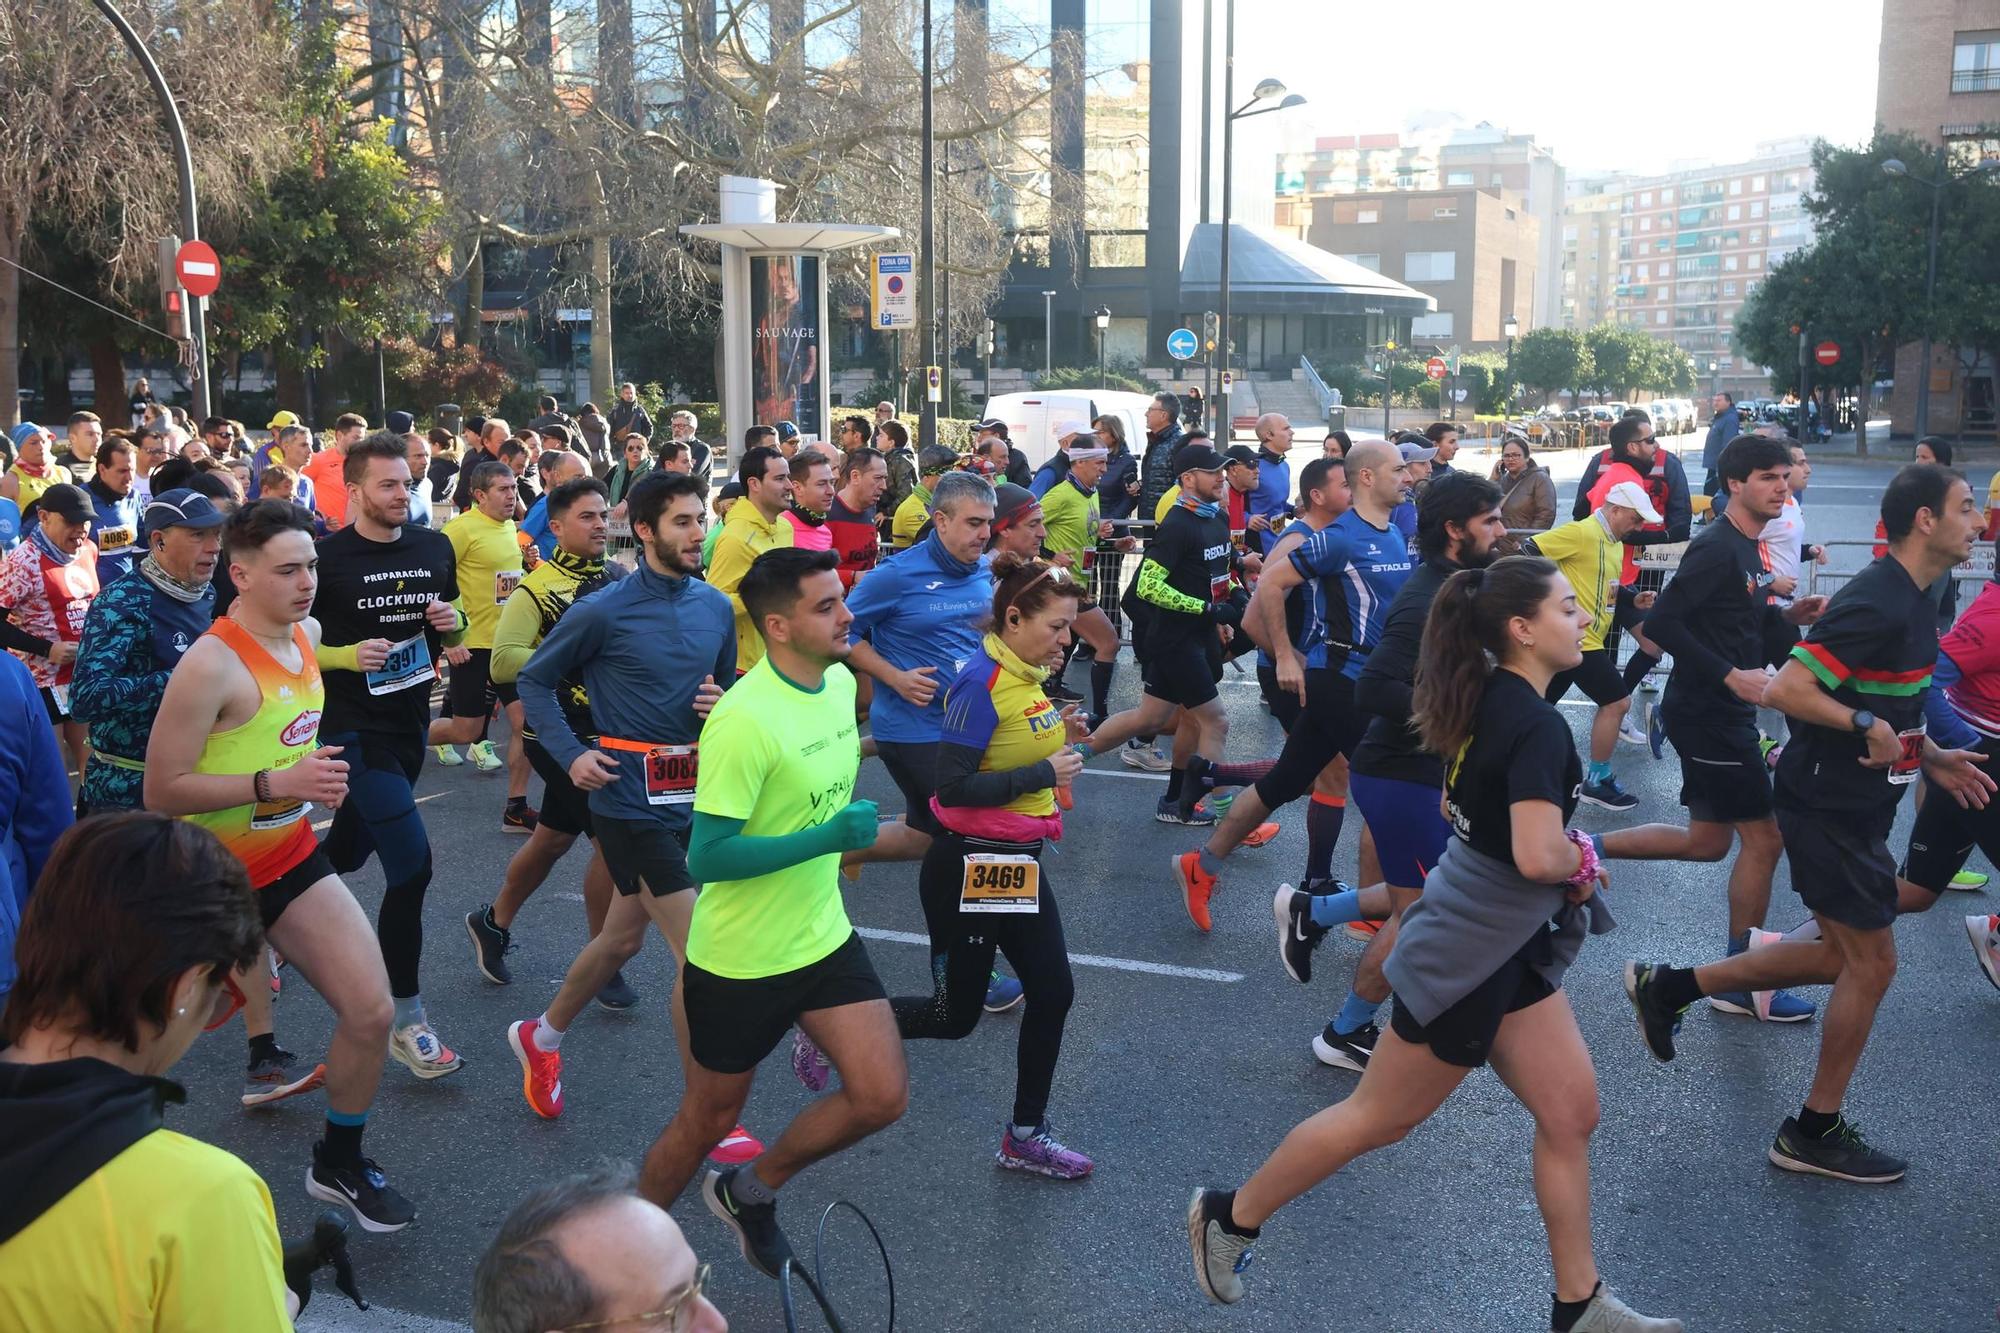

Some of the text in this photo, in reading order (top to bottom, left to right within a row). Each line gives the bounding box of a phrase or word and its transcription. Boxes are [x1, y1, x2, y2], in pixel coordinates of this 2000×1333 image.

[880, 257, 910, 266] ZONA ORA
[755, 327, 815, 338] SAUVAGE
[104, 530, 128, 544] 4085
[1371, 562, 1411, 572] STADLE
[363, 568, 432, 584] PREPARACIÓN
[357, 592, 440, 610] CLOCKWORK
[943, 602, 968, 613] Running
[379, 612, 423, 623] BOMBERO
[654, 756, 698, 781] 3082
[810, 774, 850, 810] V TRAIL
[972, 865, 1026, 890] 3469
